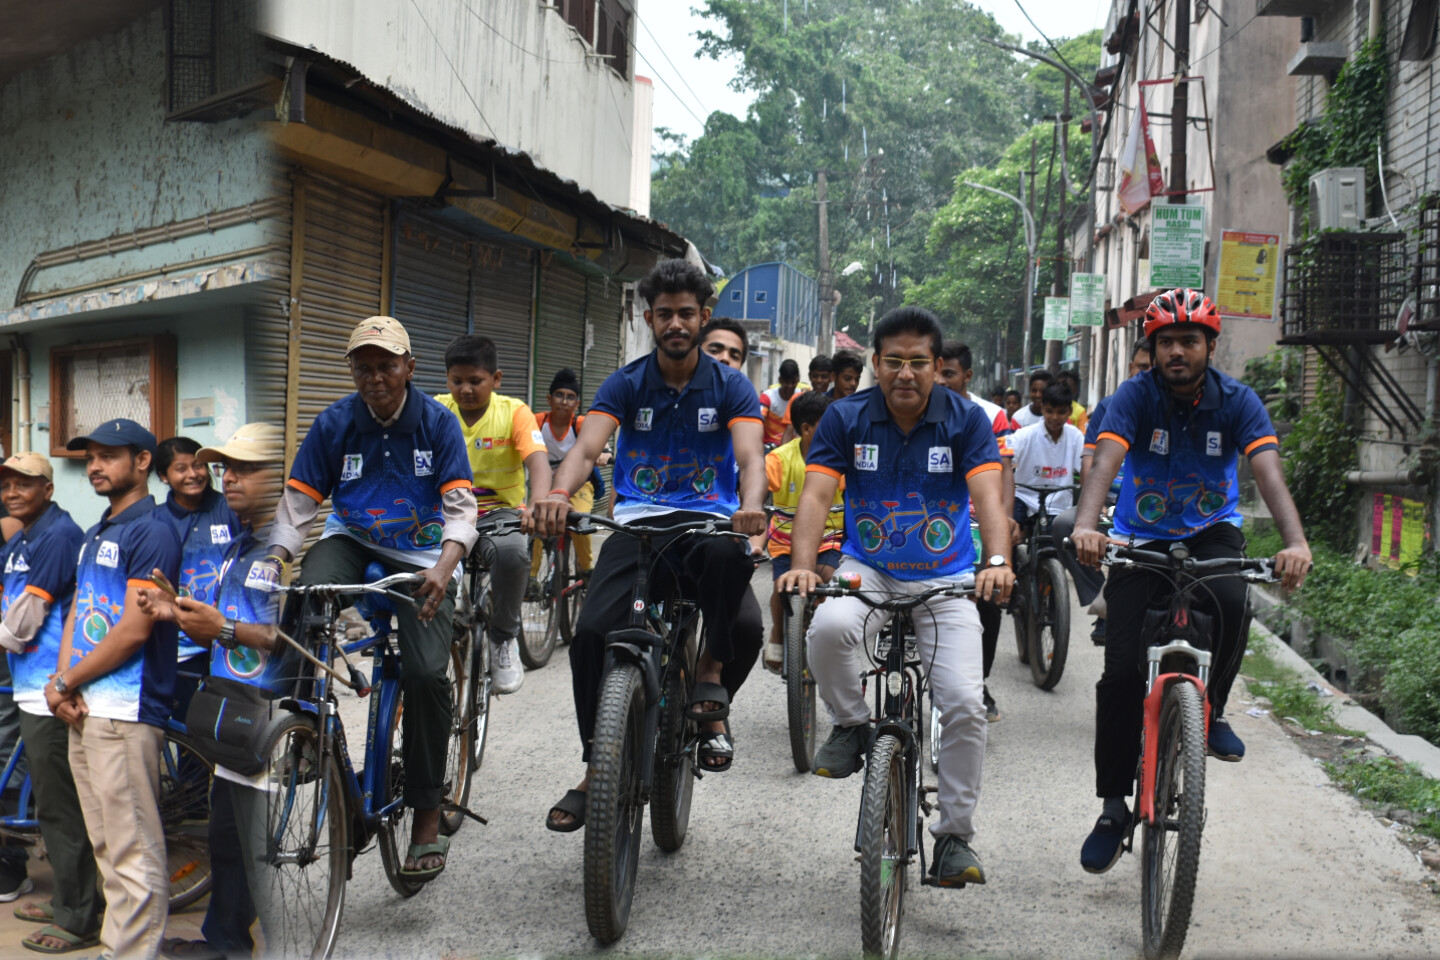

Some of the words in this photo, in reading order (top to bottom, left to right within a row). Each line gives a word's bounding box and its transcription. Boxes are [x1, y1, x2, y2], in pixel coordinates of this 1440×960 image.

[98, 544, 118, 563] SAI
[249, 566, 271, 583] SAI
[887, 561, 940, 571] BICYCLE
